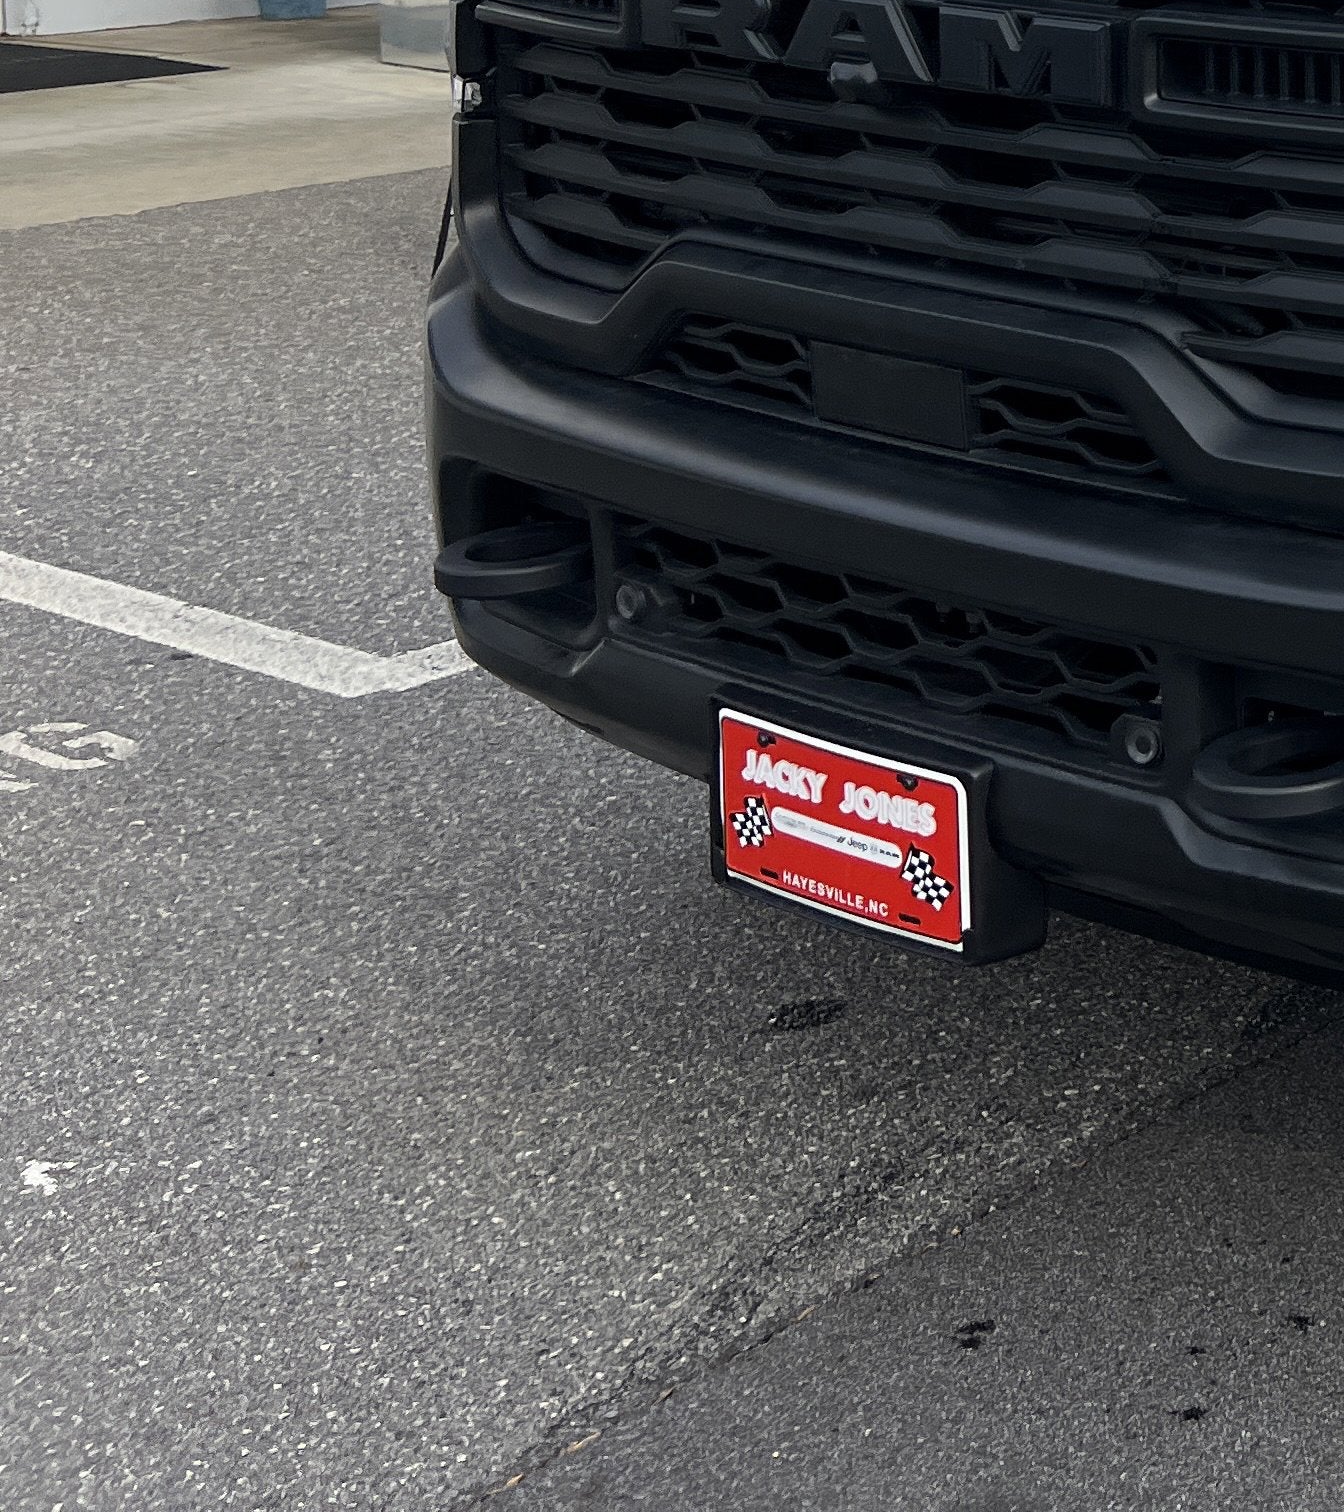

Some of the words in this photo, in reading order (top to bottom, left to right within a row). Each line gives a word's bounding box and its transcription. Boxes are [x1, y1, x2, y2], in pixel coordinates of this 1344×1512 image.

[741, 749, 827, 803] JACKY
[839, 781, 936, 836] JONES
[847, 836, 869, 852] Jeep
